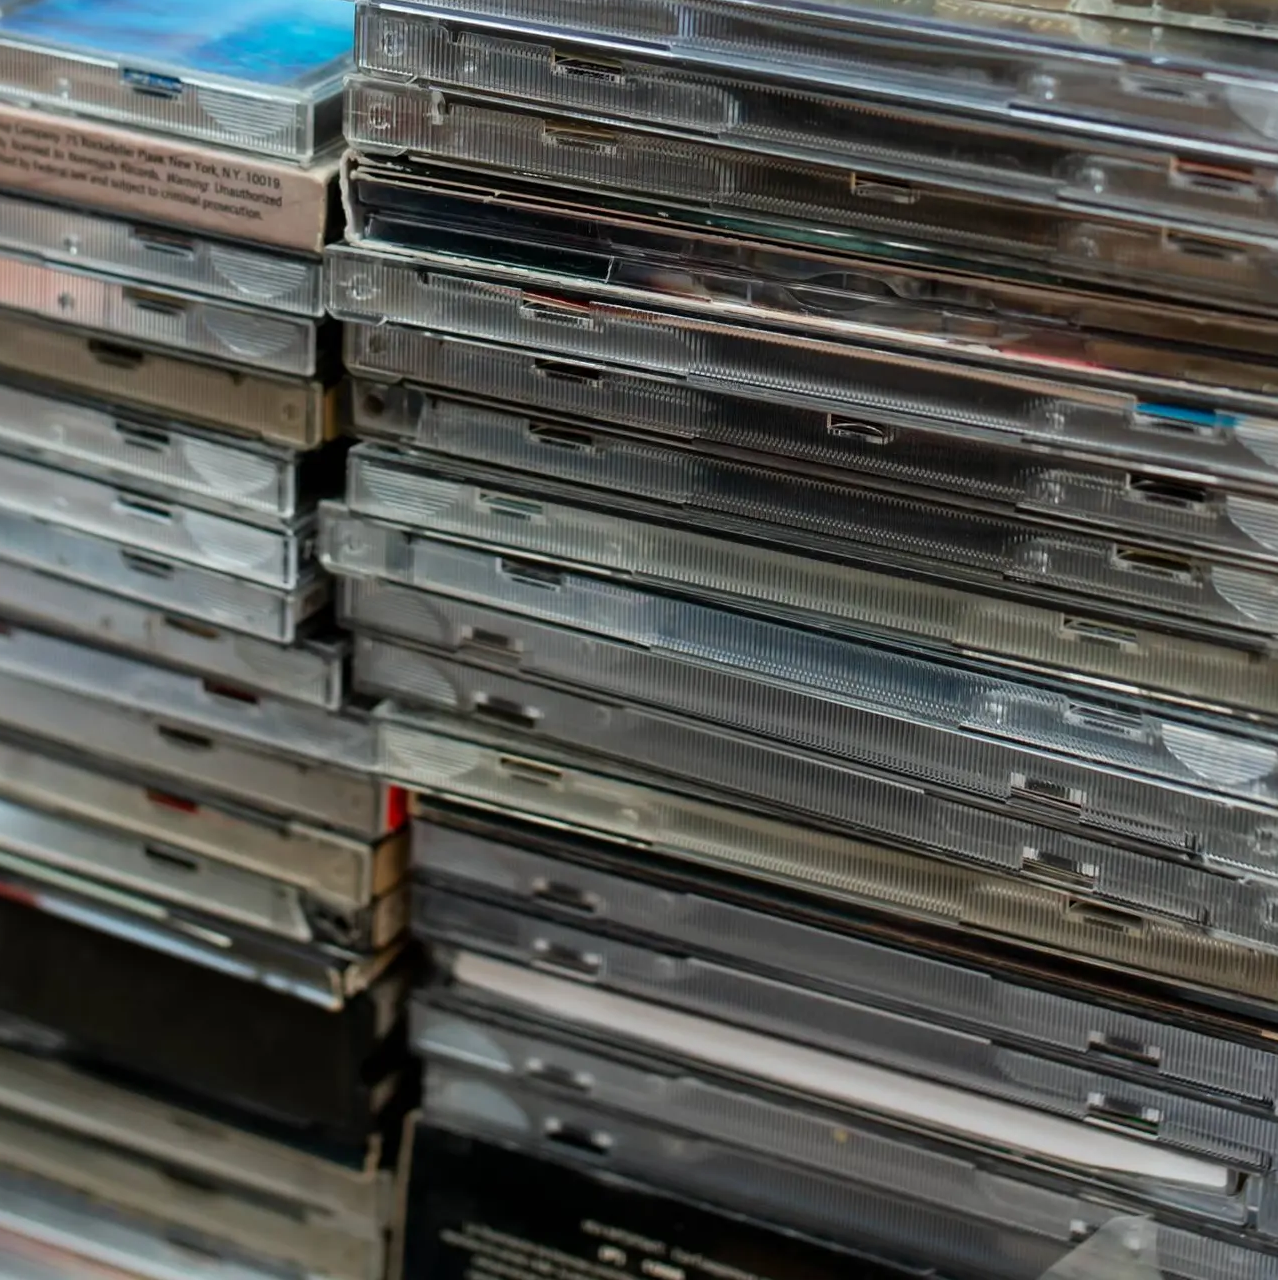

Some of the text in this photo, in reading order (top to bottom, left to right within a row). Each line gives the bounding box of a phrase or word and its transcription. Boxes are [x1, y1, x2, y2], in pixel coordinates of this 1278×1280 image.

[170, 154, 192, 171] New
[193, 161, 219, 180] York,
[70, 167, 88, 183] law
[90, 171, 109, 188] and
[110, 173, 147, 198] subject
[148, 185, 159, 199] to
[160, 187, 201, 208] criminal
[214, 181, 283, 209] Unauthorized
